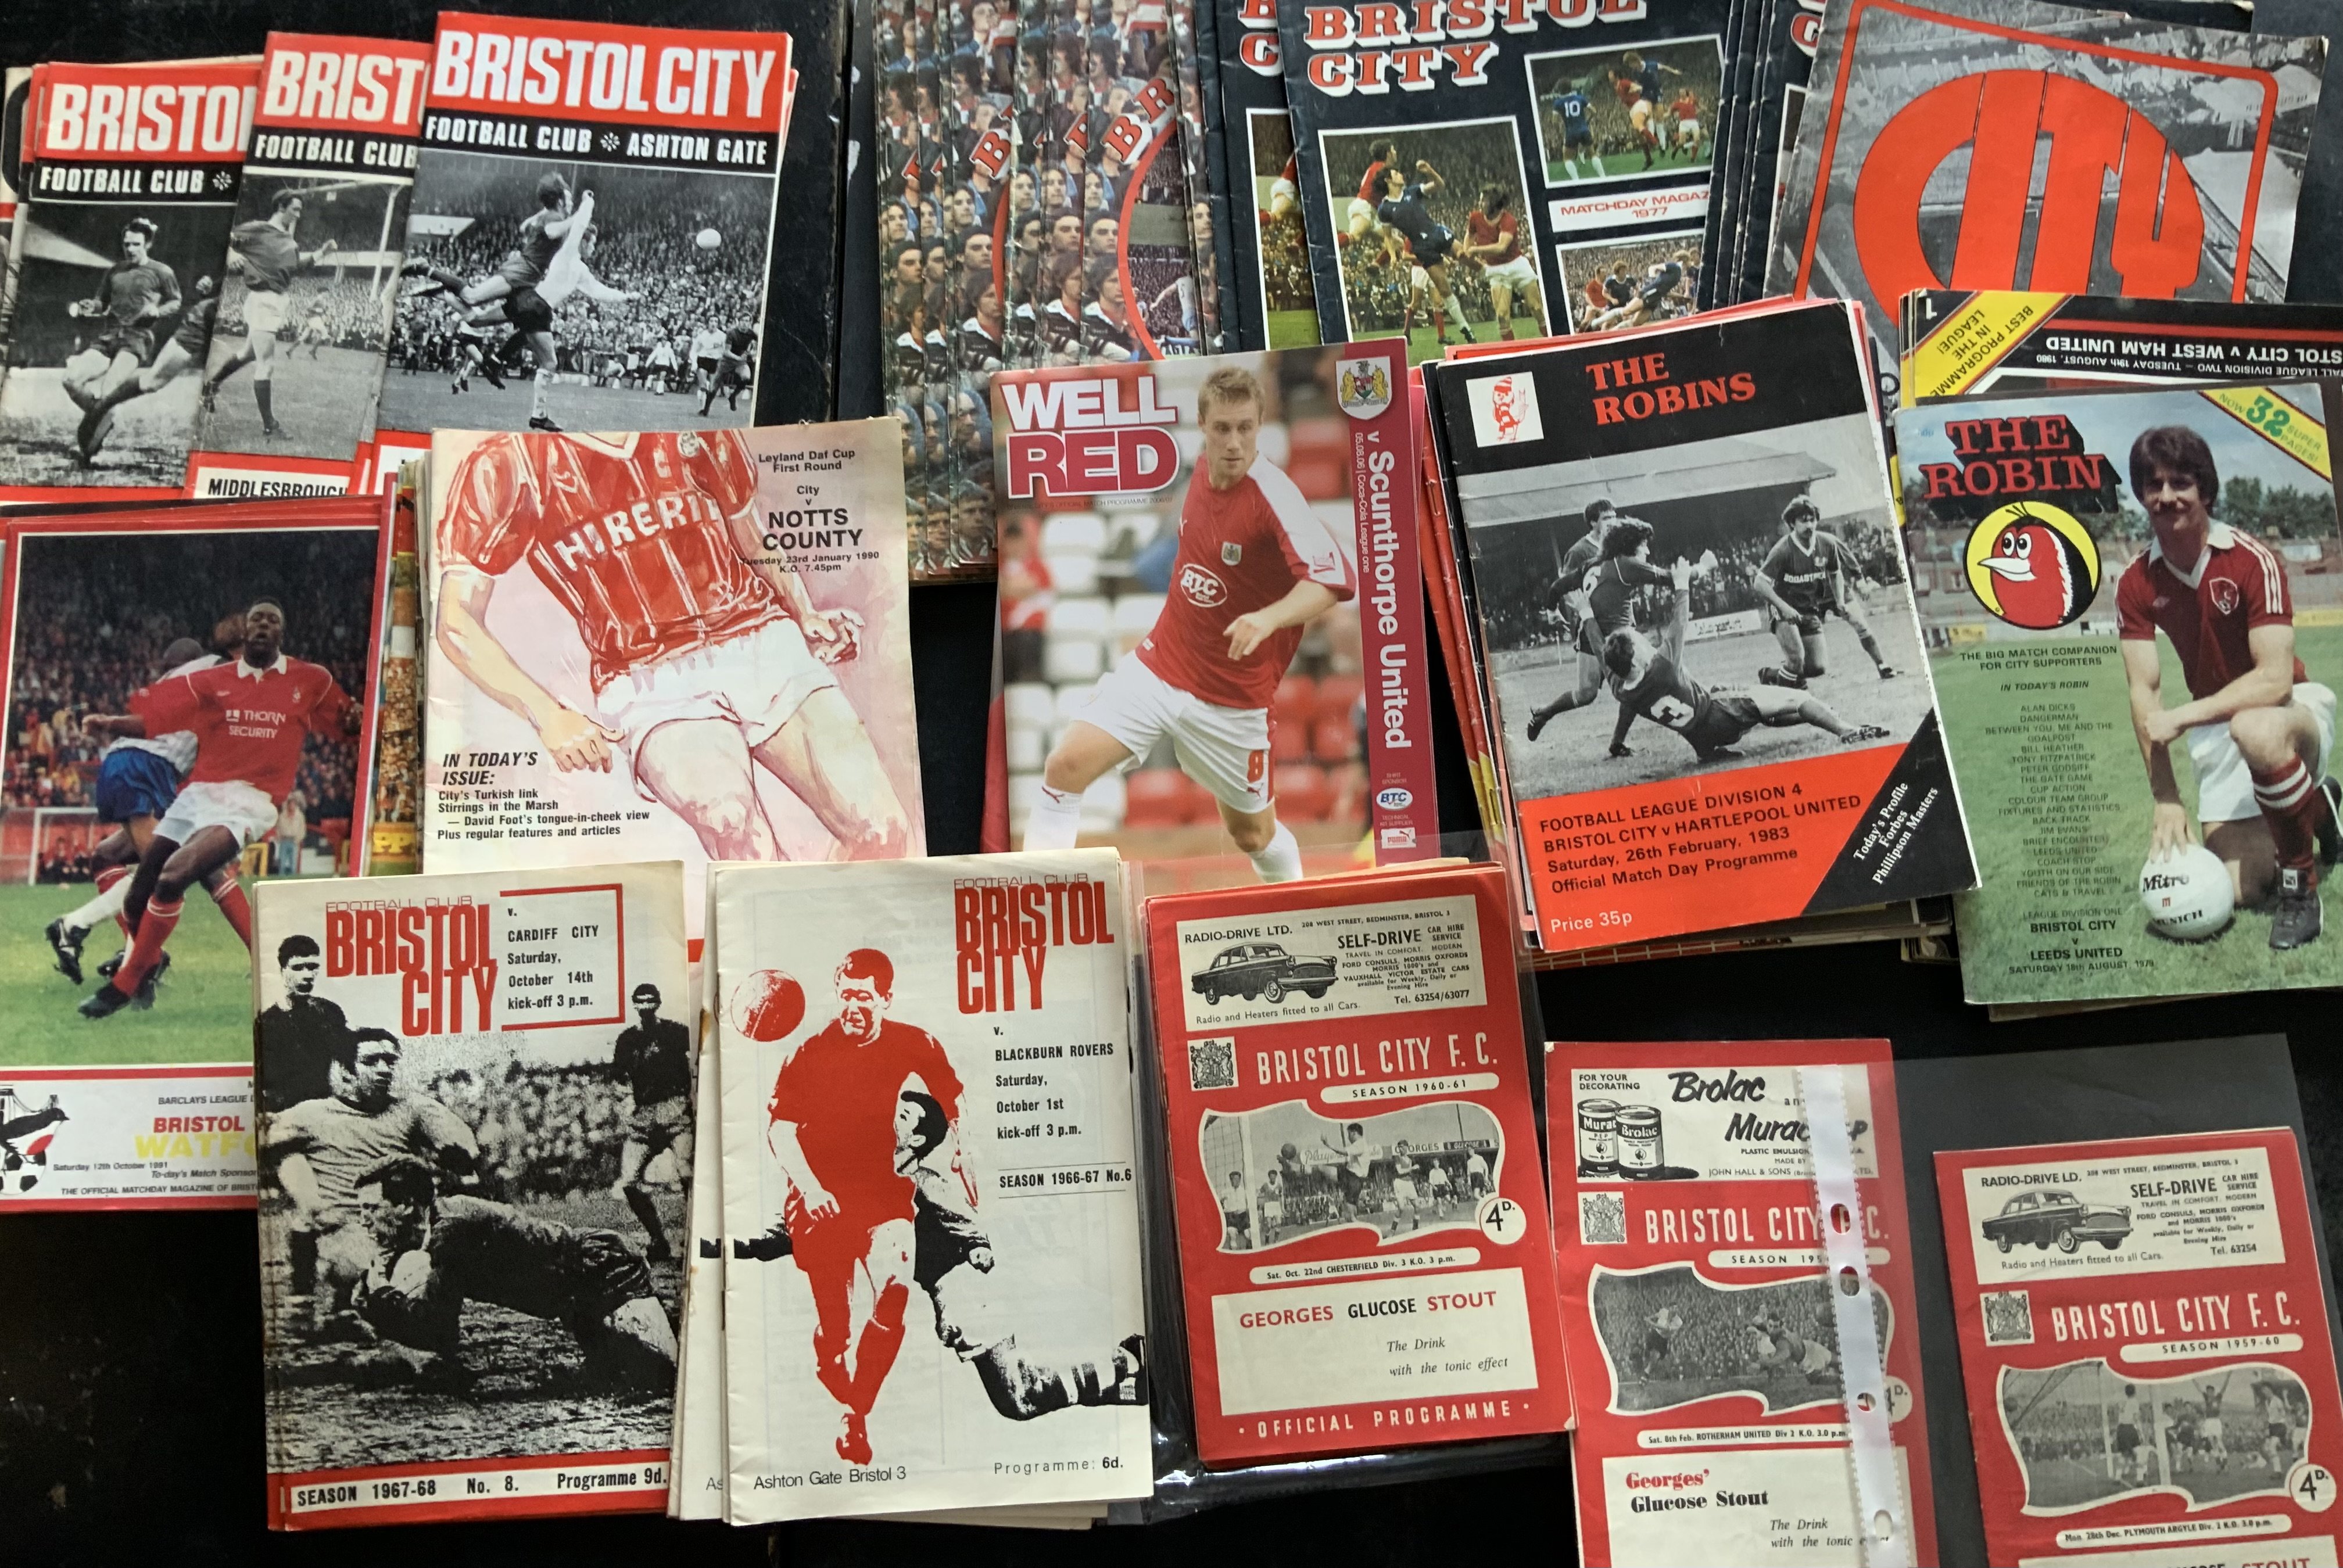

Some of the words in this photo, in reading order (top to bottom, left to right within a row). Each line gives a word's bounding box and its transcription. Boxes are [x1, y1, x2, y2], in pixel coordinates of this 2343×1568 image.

[432, 30, 649, 111] BRISTOL
[655, 47, 776, 118] CITY
[1307, 42, 1499, 96] CITY
[263, 50, 431, 126] BRIST
[1564, 100, 1581, 117] 10
[255, 134, 354, 164] FOOTBALL
[363, 145, 418, 168] CLUB
[426, 116, 528, 149] FOOTBALL
[538, 127, 592, 152] CLUB
[627, 132, 708, 162] ASHTON
[717, 140, 767, 165] GATE
[40, 166, 142, 193] FOOTBALL
[151, 168, 205, 194] CLUB
[1561, 199, 1647, 216] MATCHDAY
[1632, 207, 1668, 218] 1977
[2005, 306, 2034, 334] BEST
[1937, 310, 1985, 355] LEAGUE!
[1975, 324, 1991, 339] IN
[1952, 339, 1977, 360] THE
[2046, 336, 2115, 353] UNITED
[2122, 342, 2169, 357] HAM
[2172, 345, 2224, 360] WEST
[2231, 348, 2240, 356] v
[2247, 347, 2288, 362] CITY
[1586, 353, 1669, 392] THE
[1000, 375, 1178, 430] WELL
[1593, 373, 1757, 426] ROBINS
[2219, 393, 2244, 414] NOW
[2247, 395, 2290, 437] 32
[1946, 414, 2077, 456] THE
[759, 452, 804, 464] Leyland
[809, 451, 829, 460] Daf
[833, 449, 855, 459] Cup
[773, 464, 800, 473] First
[804, 461, 842, 471] Round
[1005, 426, 1180, 498] RED
[1920, 453, 2112, 507] ROBIN
[768, 508, 848, 529] NOTTS
[762, 529, 863, 551] COUNTY
[1368, 450, 1399, 635] Scunthorpe
[1181, 568, 1218, 596] BTC
[1960, 652, 1981, 661] THE
[2009, 649, 2048, 658] MATCH
[2052, 646, 2118, 656] COMPANION
[1980, 662, 2002, 671] FOR
[2006, 661, 2030, 669] CITY
[2033, 658, 2102, 668] SUPPORTERS
[1380, 644, 1412, 749] United
[243, 710, 286, 726] THORN
[229, 726, 278, 738] SECURITY
[443, 754, 460, 767] IN
[469, 752, 538, 767] TODAY'S
[442, 771, 495, 785] ISSUE:
[439, 802, 484, 813] Stirrings
[490, 802, 499, 811] in
[504, 801, 521, 811] the
[525, 800, 558, 810] Marsh
[1540, 812, 1625, 833] FOOTBALL
[1631, 799, 1699, 820] LEAGUE
[1705, 786, 1786, 809] DIVISION
[1792, 783, 1803, 795] 4
[1544, 834, 1615, 853] BRISTOL
[1619, 825, 1657, 842] CITY
[1662, 827, 1671, 836] v
[1675, 809, 1787, 834] HARTLEPOOL
[1794, 795, 1861, 817] UNITED
[1627, 847, 1663, 863] 26th
[1749, 827, 1790, 844] 1983
[1872, 831, 1912, 885] Phillipson
[1906, 787, 1938, 830] Masters
[954, 876, 1038, 889] FOOTBALL
[1044, 873, 1088, 884] CLUB
[1552, 877, 1607, 894] Official
[1612, 867, 1663, 885] Match
[1668, 863, 1699, 877] Day
[1706, 848, 1798, 871] Programme
[2143, 874, 2190, 893] Mitre
[954, 881, 1115, 952] BRISTOL
[1550, 917, 1594, 934] Price
[1599, 912, 1633, 930] 35p
[2030, 921, 2084, 934] BRISTOL
[2088, 920, 2116, 931] CITY
[326, 904, 497, 978] BRISTOL
[507, 928, 559, 943] CARDIFF
[572, 925, 599, 939] CITY
[1185, 928, 1261, 943] RADIO-DRIVE
[1267, 925, 1293, 935] LTD.
[1338, 929, 1422, 949] SELF-DRIVE
[2031, 949, 2070, 960] LEEDS
[2075, 948, 2123, 959] UNITED
[508, 974, 554, 988] October
[568, 970, 593, 985] 14th
[957, 945, 1046, 1014] CITY
[402, 965, 499, 1036] CITY
[995, 1046, 1063, 1061] BLACKBURN
[1070, 1043, 1113, 1057] ROVERS
[1256, 1043, 1365, 1085] BRISTOL
[1379, 1036, 1431, 1075] CITY
[1352, 1085, 1409, 1098] SEASON
[1415, 1079, 1467, 1092] 1960-61
[1668, 1069, 1765, 1102] Brolac
[153, 1115, 245, 1133] BRISTOL
[999, 1174, 1044, 1188] SEASON
[1052, 1170, 1099, 1185] 1966-67
[1982, 1174, 2059, 1187] RADIO-DRIVE
[2130, 1178, 2217, 1198] SELF-DRIVE
[1645, 1207, 1753, 1244] BRISTOL
[1239, 1305, 1334, 1329] GEORGES
[1348, 1298, 1416, 1318] GLUCOSE
[1427, 1290, 1496, 1311] STOUT
[2051, 1301, 2165, 1342] BRISTOL
[2177, 1296, 2230, 1332] CITY
[2162, 1340, 2219, 1354] SEASON
[2226, 1336, 2280, 1350] 1959-60
[1257, 1413, 1354, 1438] OFFICIAL
[1374, 1400, 1511, 1427] PROGRAMME
[296, 1486, 357, 1508] SEASON
[371, 1480, 436, 1501] 1967-68
[467, 1477, 490, 1495] No.
[504, 1475, 520, 1492] 8.
[557, 1471, 637, 1491] Programme
[644, 1466, 668, 1486] 9d.
[754, 1473, 803, 1490] Ashton
[809, 1470, 842, 1486] Gate
[850, 1467, 892, 1483] Bristol
[897, 1466, 907, 1480] 3
[1627, 1469, 1710, 1491] Georges'
[1631, 1495, 1707, 1513] Glucose
[1717, 1490, 1769, 1508] Stout
